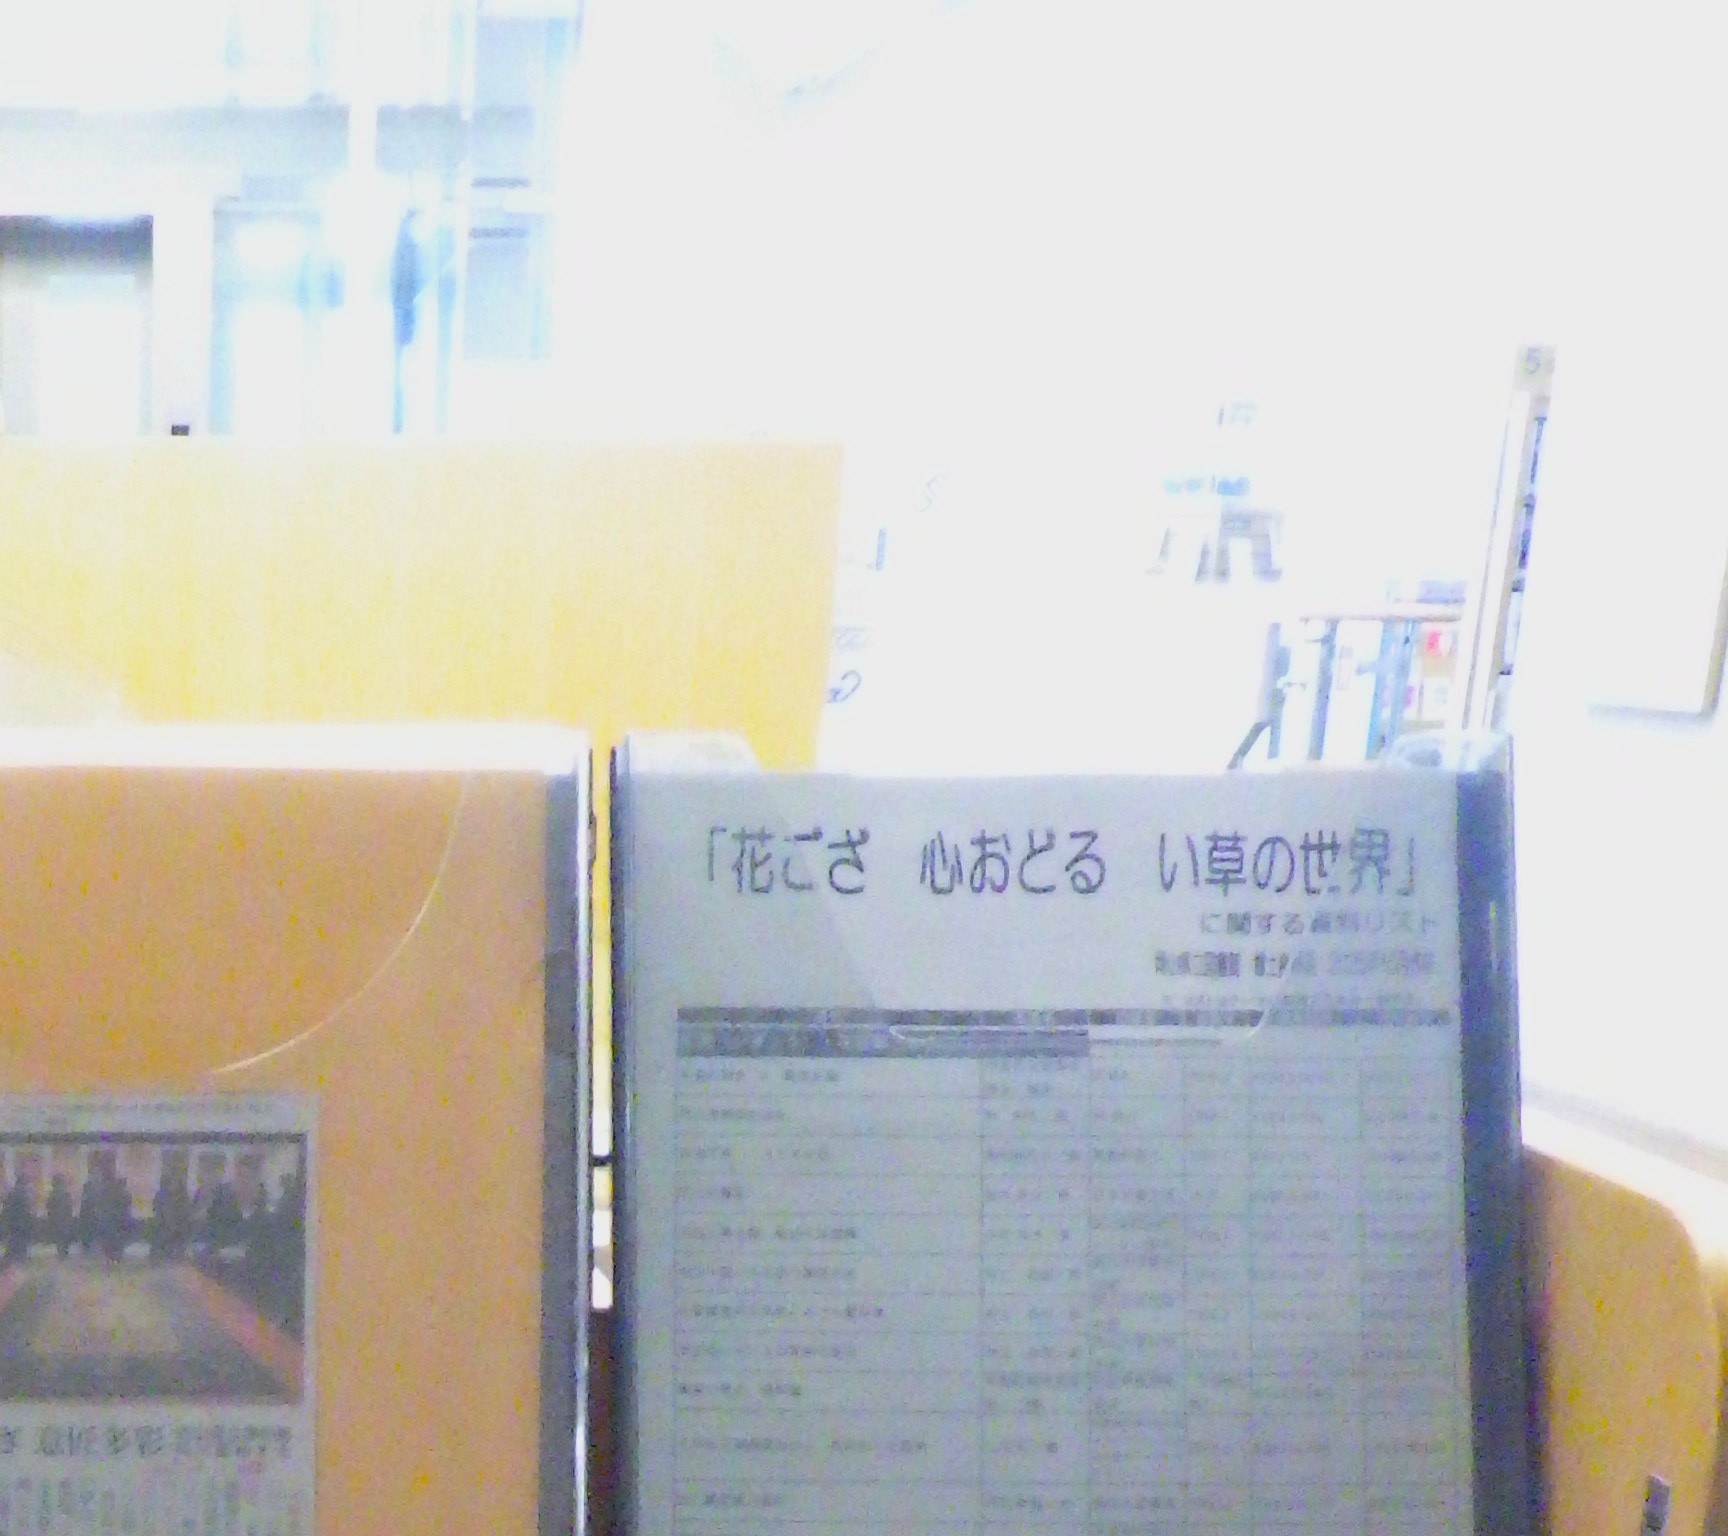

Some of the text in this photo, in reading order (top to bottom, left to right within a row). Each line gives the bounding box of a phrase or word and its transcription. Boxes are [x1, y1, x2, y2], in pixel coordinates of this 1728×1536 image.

[703, 826, 1417, 897] 「花ござ 心おどる い草の世界」
